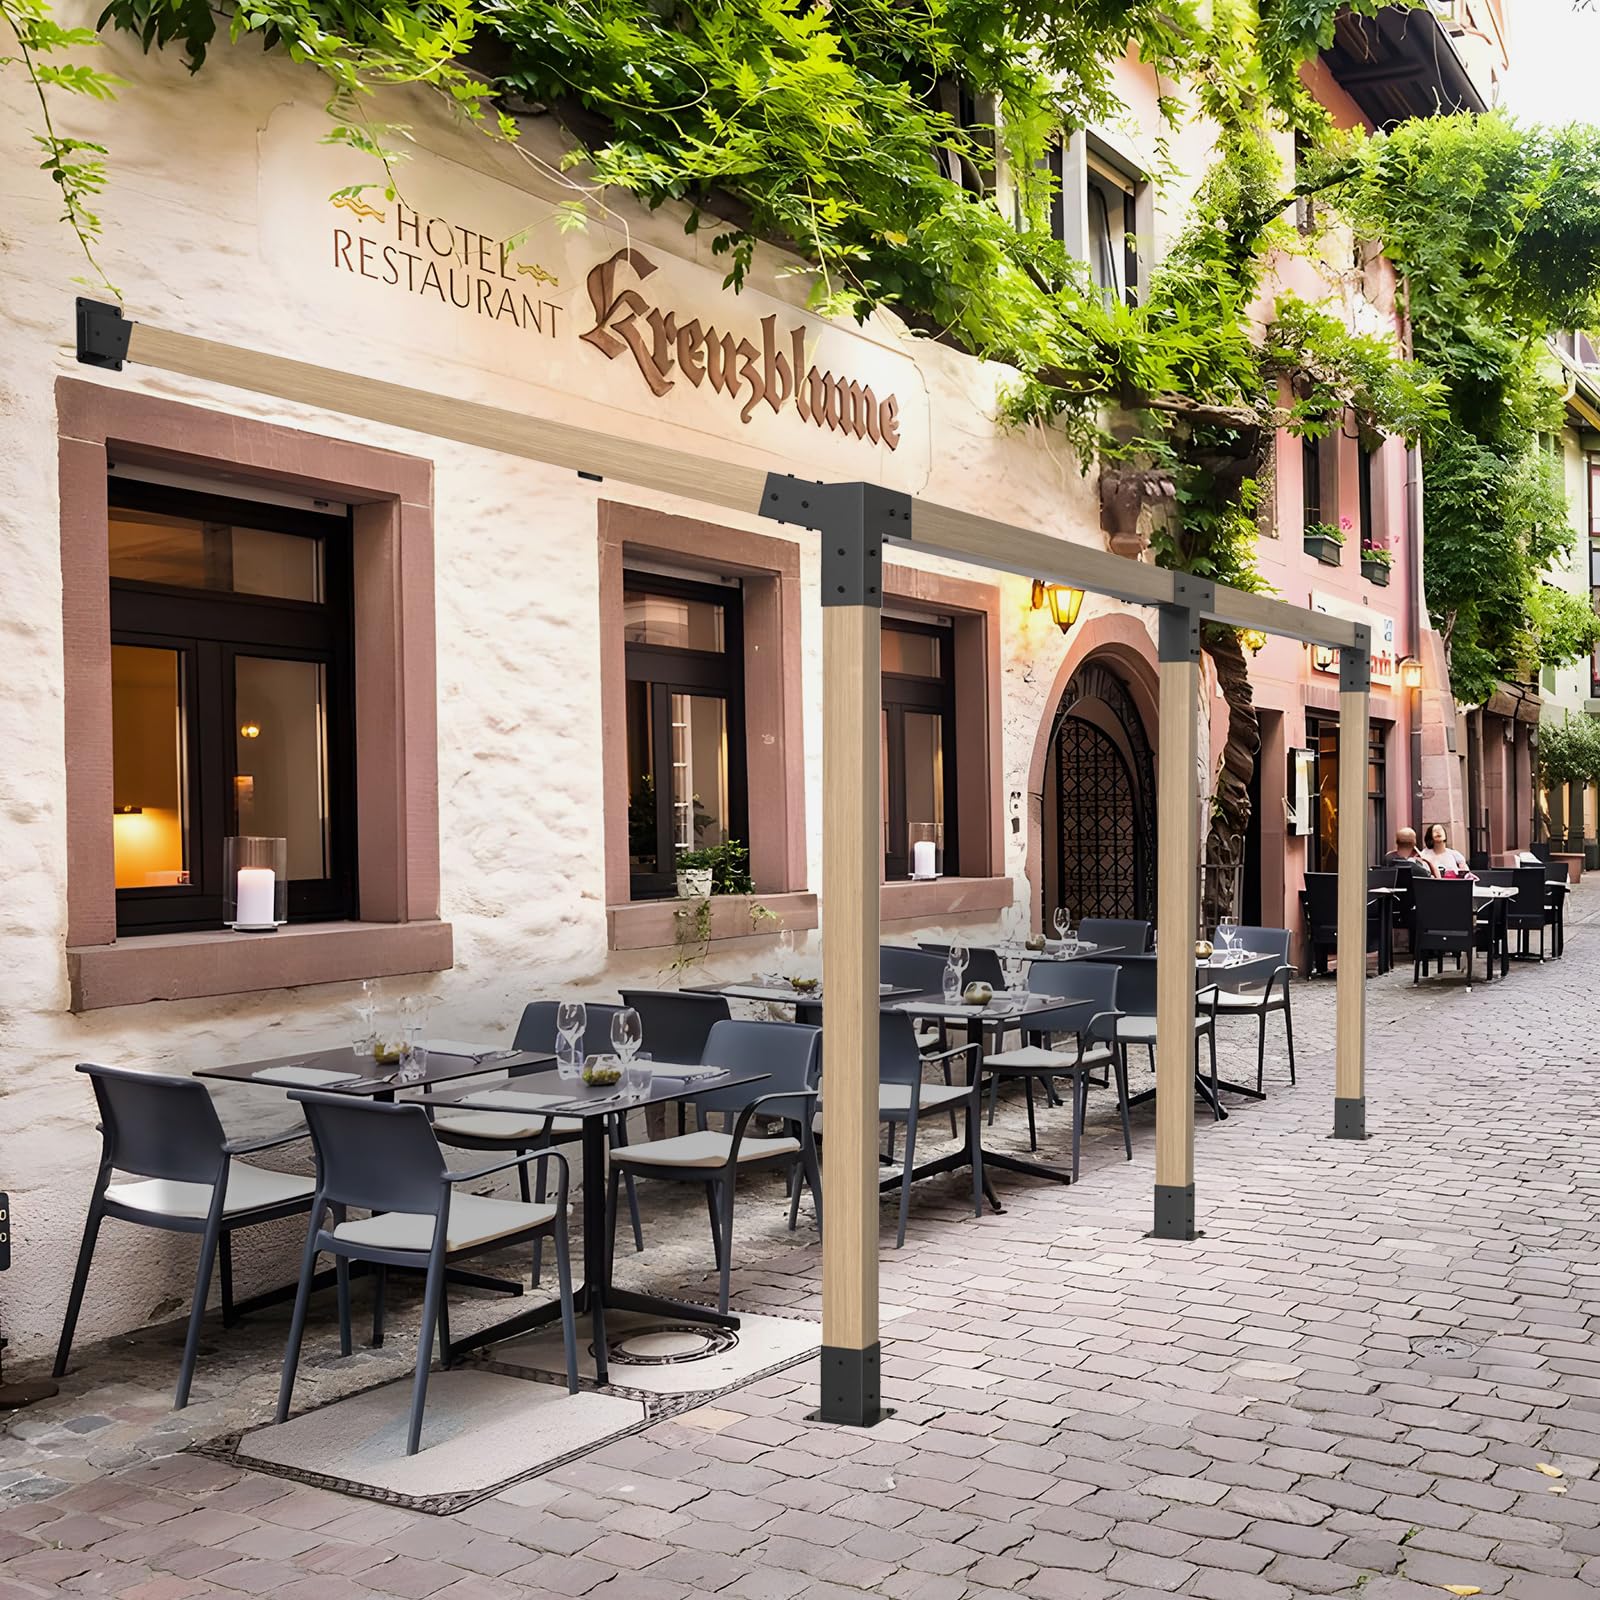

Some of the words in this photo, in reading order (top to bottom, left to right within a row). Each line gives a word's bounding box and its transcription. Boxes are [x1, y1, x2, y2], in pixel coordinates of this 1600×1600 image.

[333, 228, 564, 339] RESTAURANT
[397, 203, 517, 282] HOTEL
[579, 247, 901, 452] Kreuzblume
